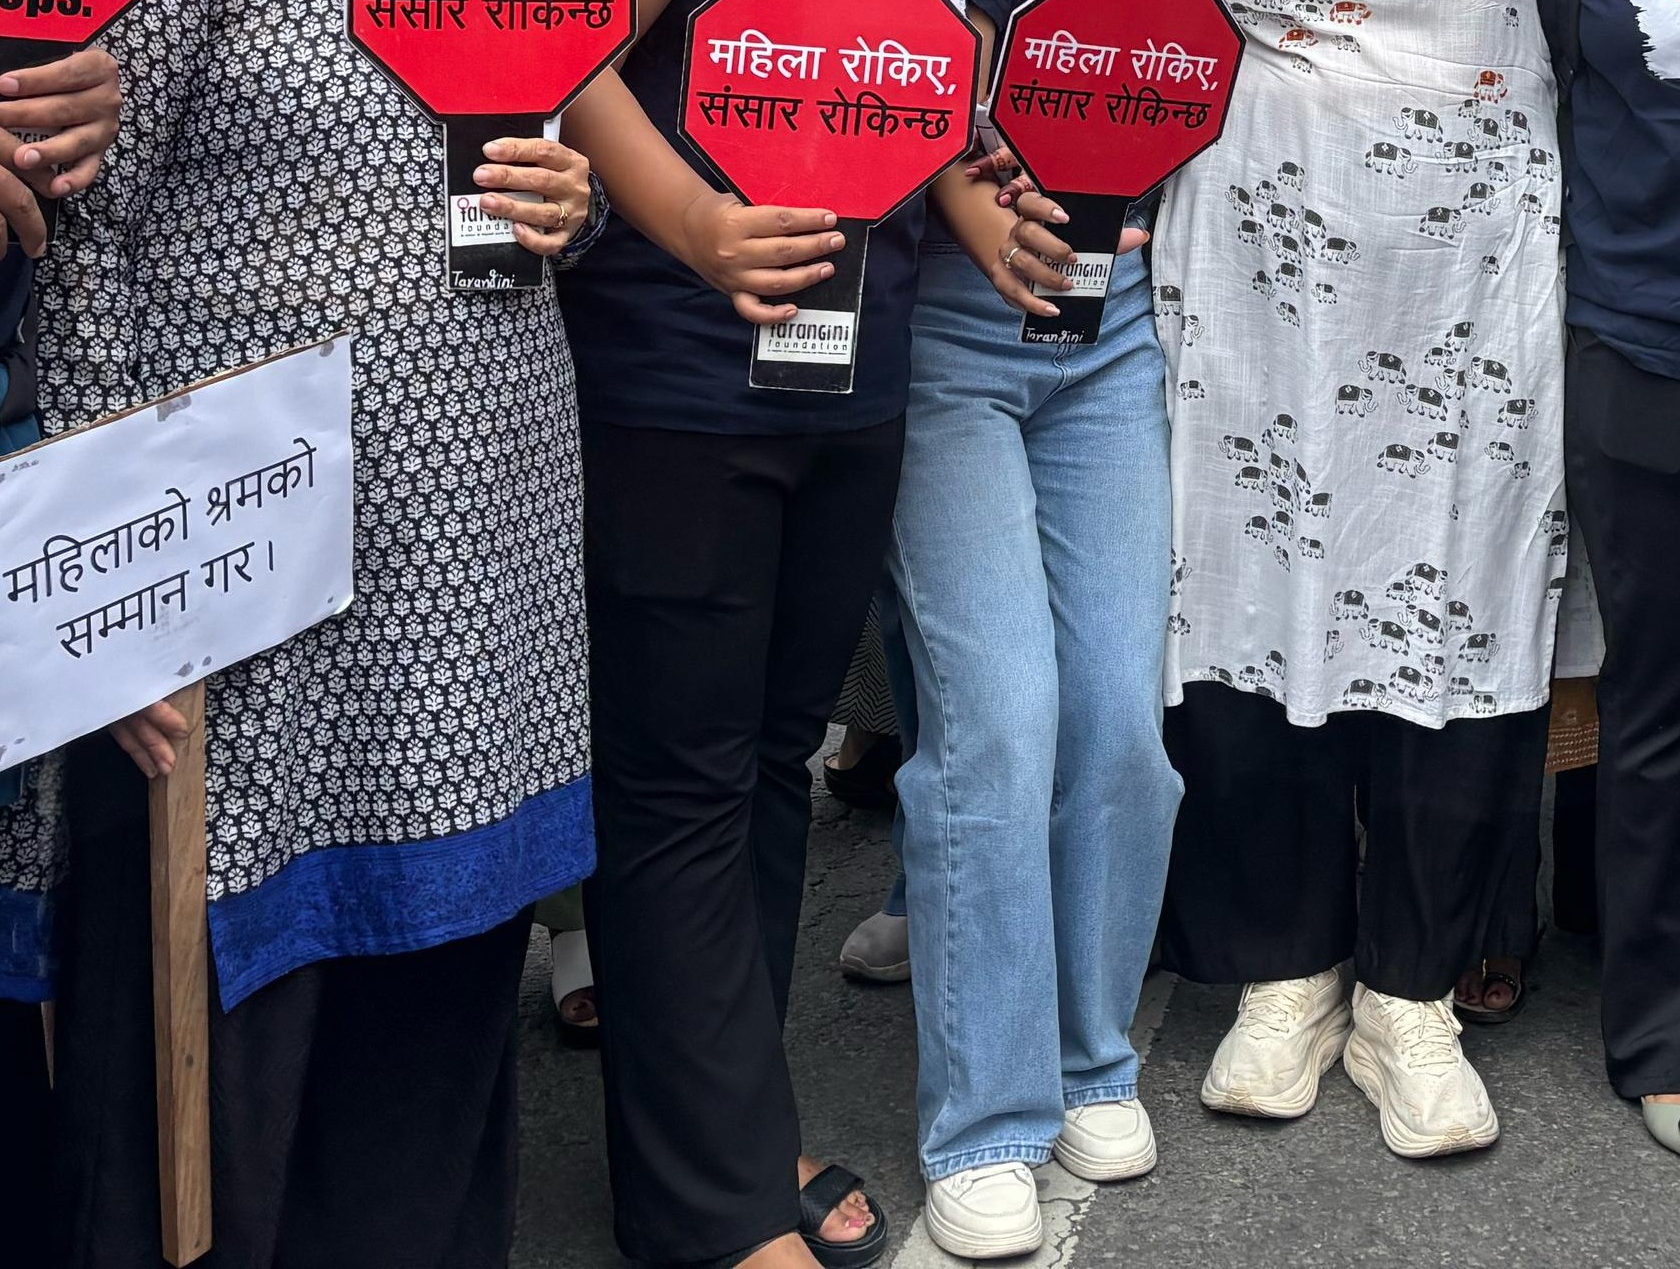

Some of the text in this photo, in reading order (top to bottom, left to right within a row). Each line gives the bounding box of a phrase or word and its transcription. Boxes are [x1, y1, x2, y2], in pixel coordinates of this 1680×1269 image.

[708, 29, 957, 96] महिला रोकिए,
[1024, 29, 1218, 91] महिला रोकिए,
[696, 85, 953, 139] संसार रोकिन्छ
[1009, 79, 1212, 129] संसार रोकिन्छ
[461, 224, 509, 233] founda
[768, 339, 848, 351] foundation
[2, 437, 317, 604] महिलाको श्रमको
[56, 570, 190, 658] सम्मान
